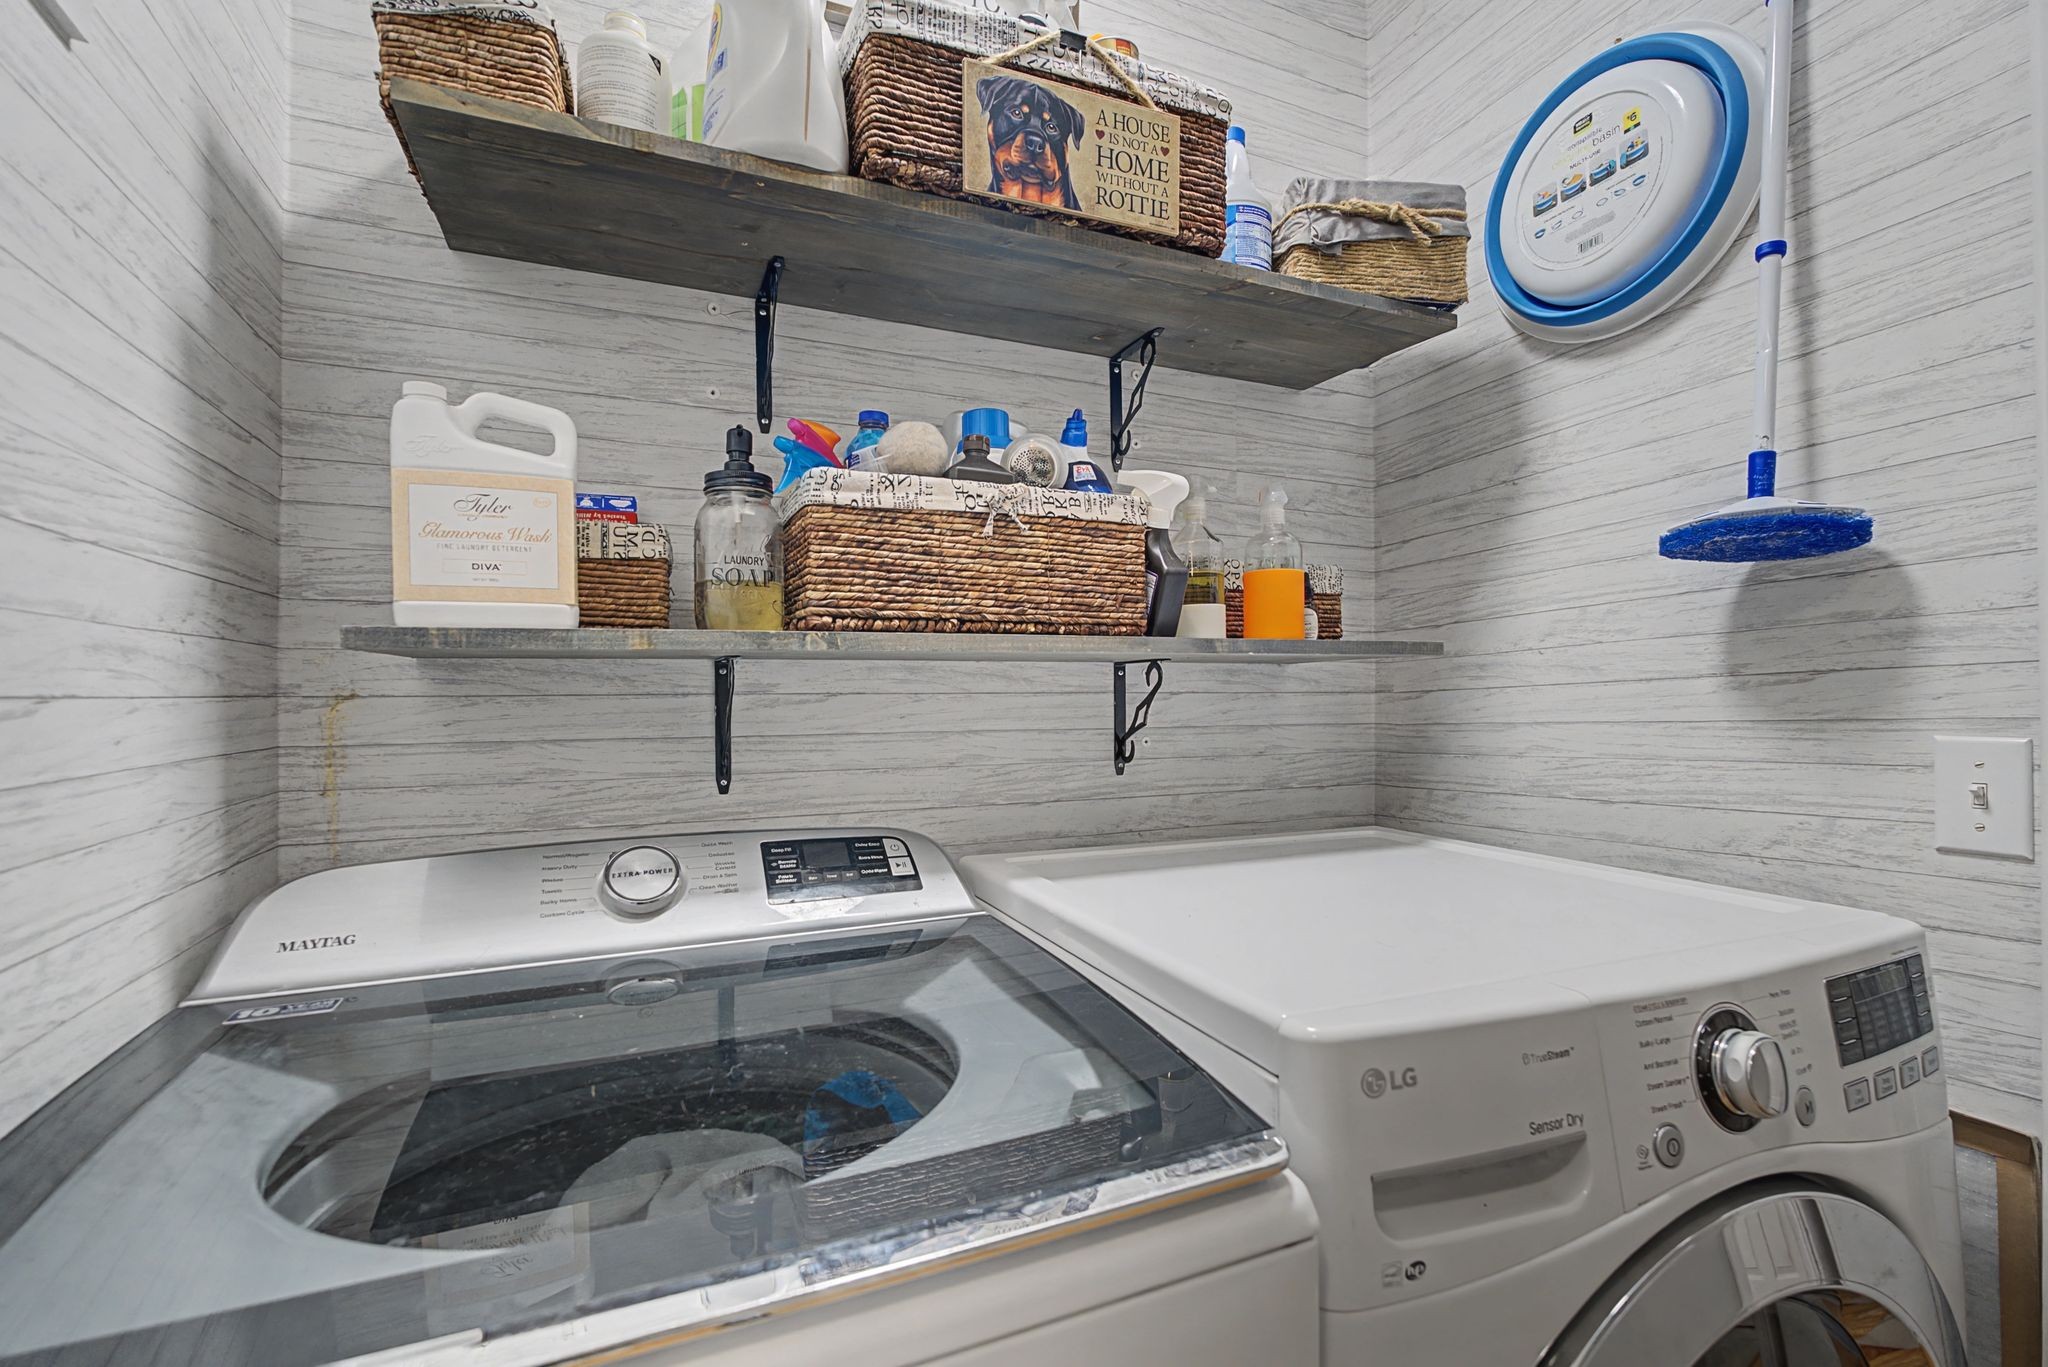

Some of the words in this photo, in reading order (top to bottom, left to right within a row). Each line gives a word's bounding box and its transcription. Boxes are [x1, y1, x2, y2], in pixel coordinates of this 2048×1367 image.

[1096, 109, 1109, 127] A
[1112, 112, 1170, 144] HOUSE
[1109, 133, 1119, 145] IS
[1121, 135, 1149, 153] NOT
[1150, 144, 1159, 156] A
[1096, 144, 1170, 183] HOME
[1096, 170, 1159, 196] WITHOUT
[1161, 186, 1169, 198] A
[1096, 186, 1170, 221] ROTTIE
[453, 493, 512, 521] Tyler
[418, 521, 504, 542] Glamorous
[507, 527, 553, 543] Wash
[471, 562, 500, 571] DIVA
[724, 555, 765, 566] LAUNDRY
[711, 567, 776, 588] SOAP
[611, 870, 640, 879] EXTRA
[643, 867, 674, 876] POWER
[276, 934, 357, 953] MAYTAG
[236, 1006, 281, 1020] 10
[1389, 1067, 1418, 1090] LG
[1529, 1117, 1564, 1136] Sensor
[1566, 1113, 1584, 1128] Dry
